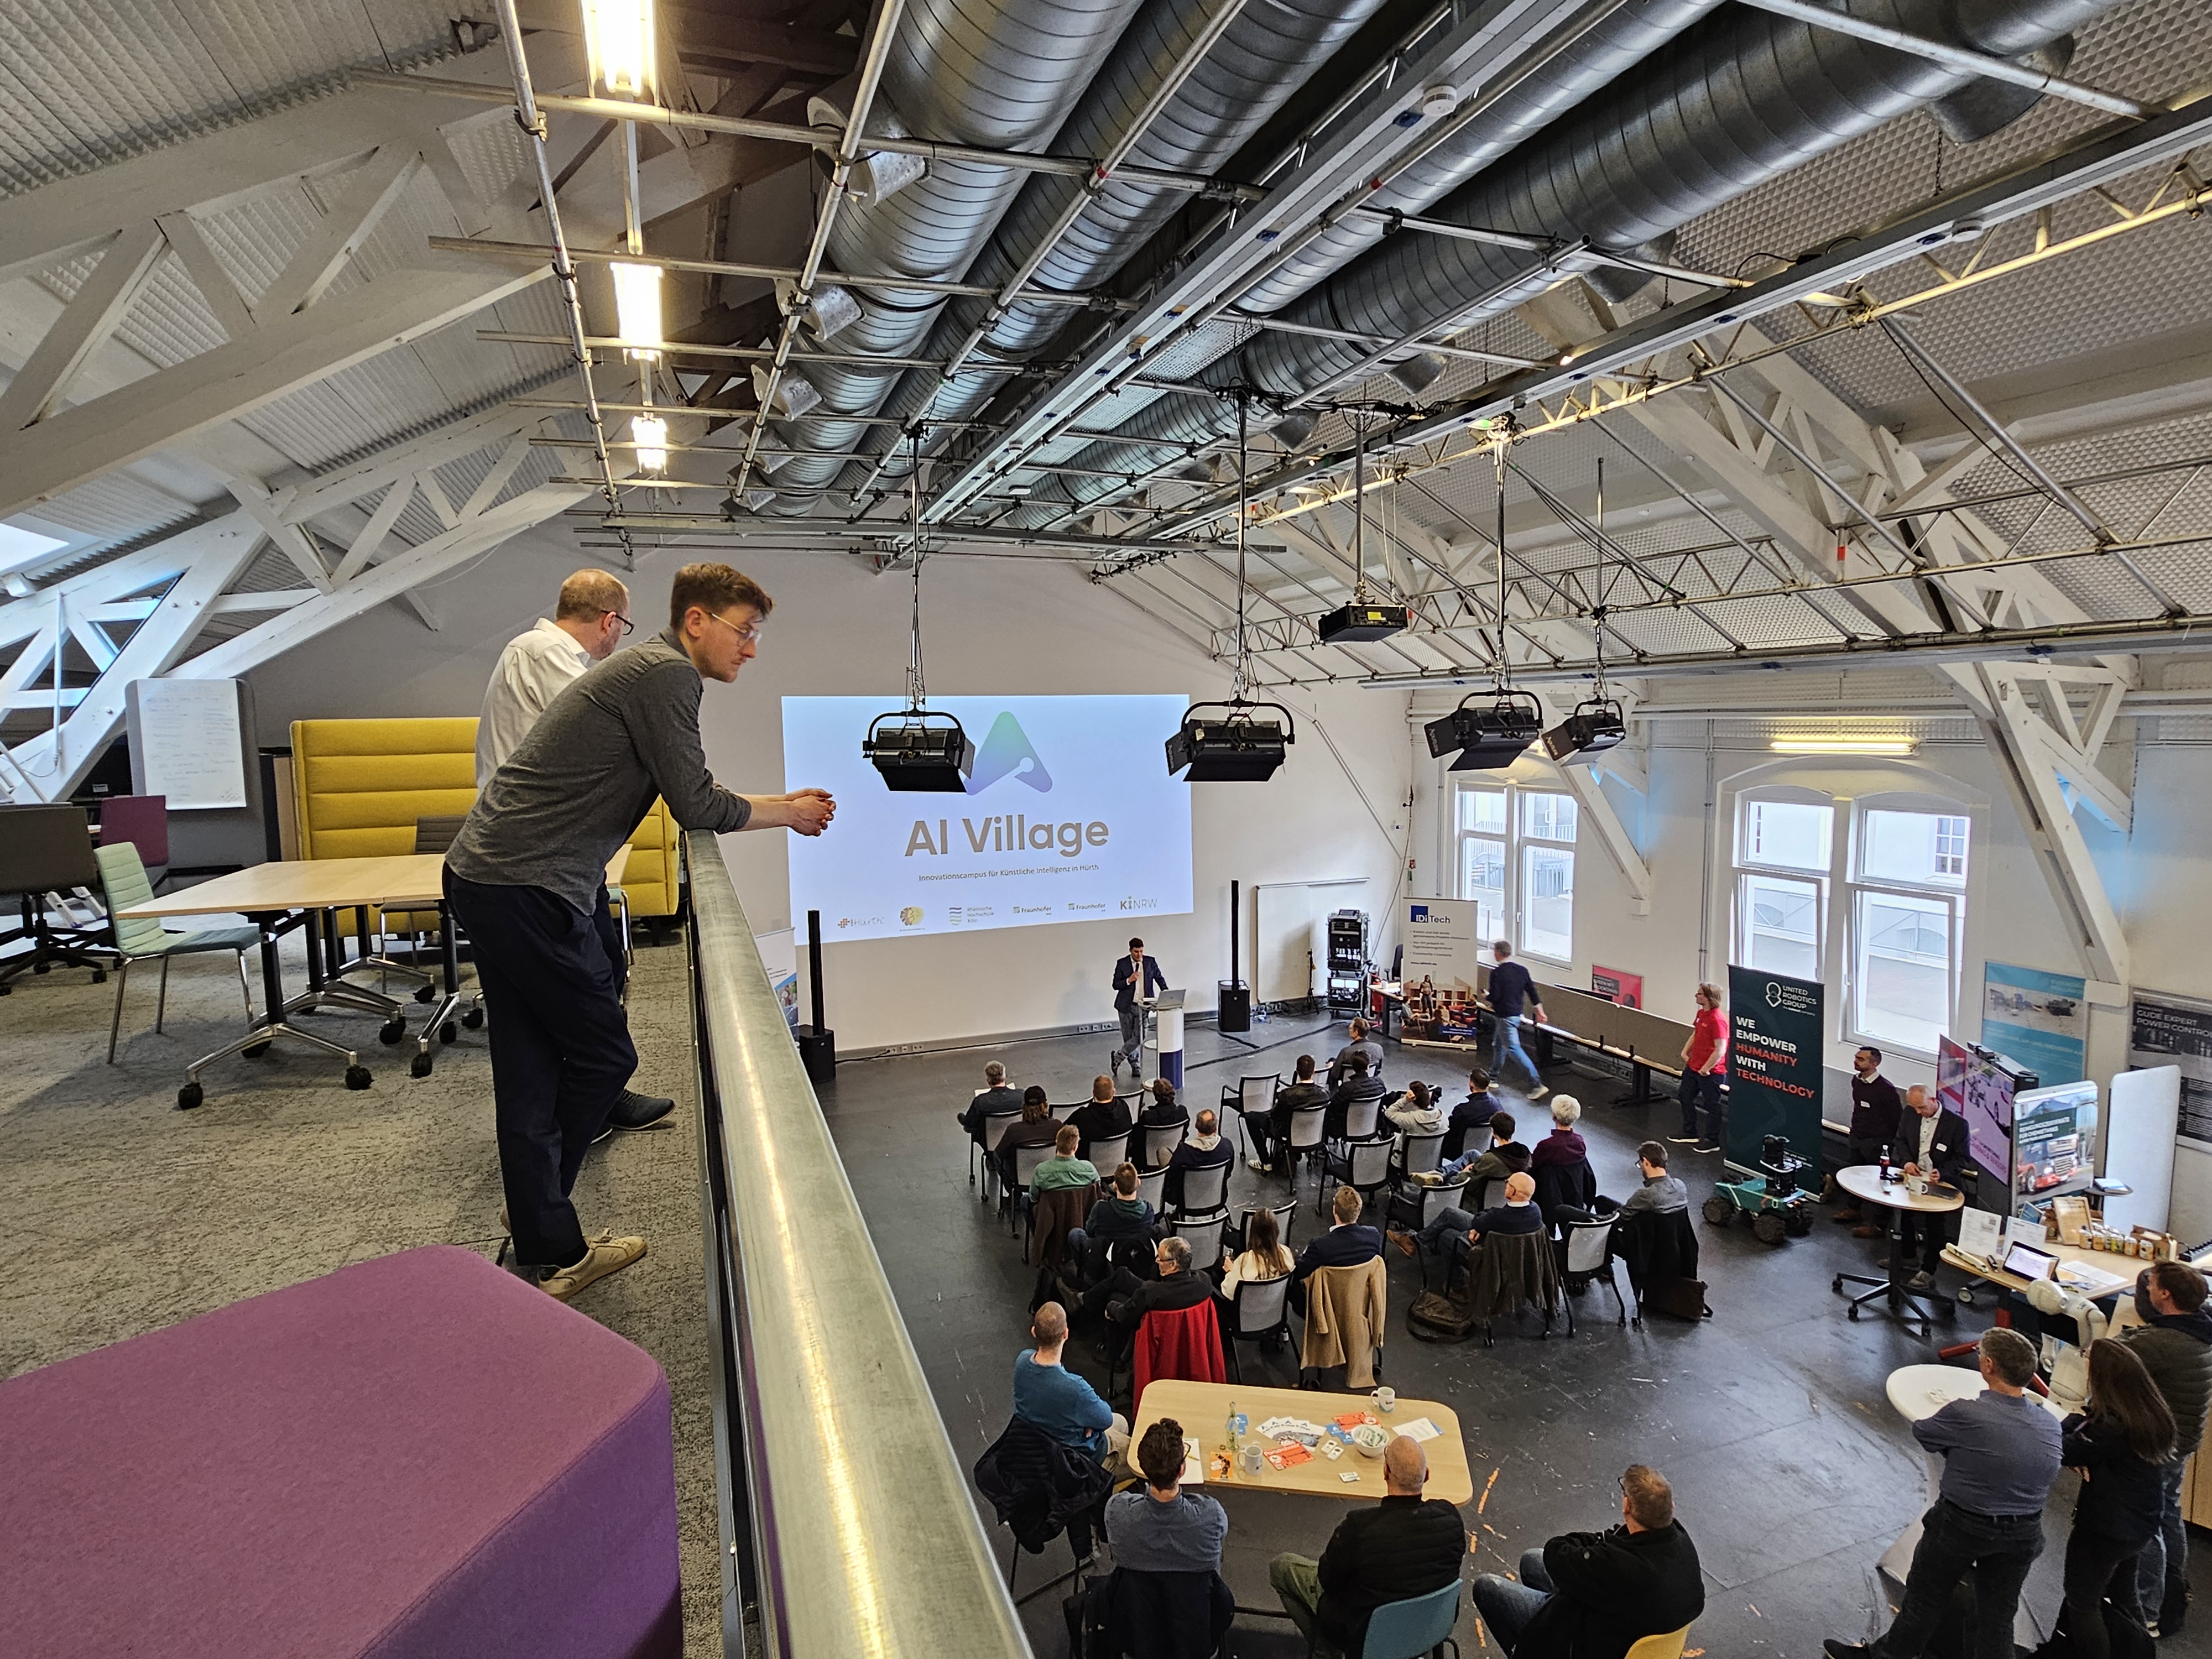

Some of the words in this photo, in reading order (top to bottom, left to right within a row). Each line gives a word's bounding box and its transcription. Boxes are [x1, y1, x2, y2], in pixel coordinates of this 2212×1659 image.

[904, 819, 948, 857] AI
[962, 814, 1109, 858] Village
[919, 871, 987, 882] Innovationscampus
[1000, 867, 1035, 876] Künstliche
[1036, 866, 1071, 874] Intelligenz
[1782, 985, 1808, 995] UNITED
[1782, 992, 1817, 1005] ROBOTICS
[1782, 999, 1807, 1009] GROUP
[1736, 1016, 1756, 1029] WE
[2137, 1010, 2163, 1020] GUDE
[2164, 1015, 2198, 1026] EXPERT
[2137, 1018, 2170, 1029] POWER
[1736, 1029, 1797, 1053] EMPOWER
[1736, 1042, 1797, 1067] HUMANITY
[1736, 1055, 1766, 1071] WITH
[1736, 1067, 1815, 1099] TECHNOLOGY
